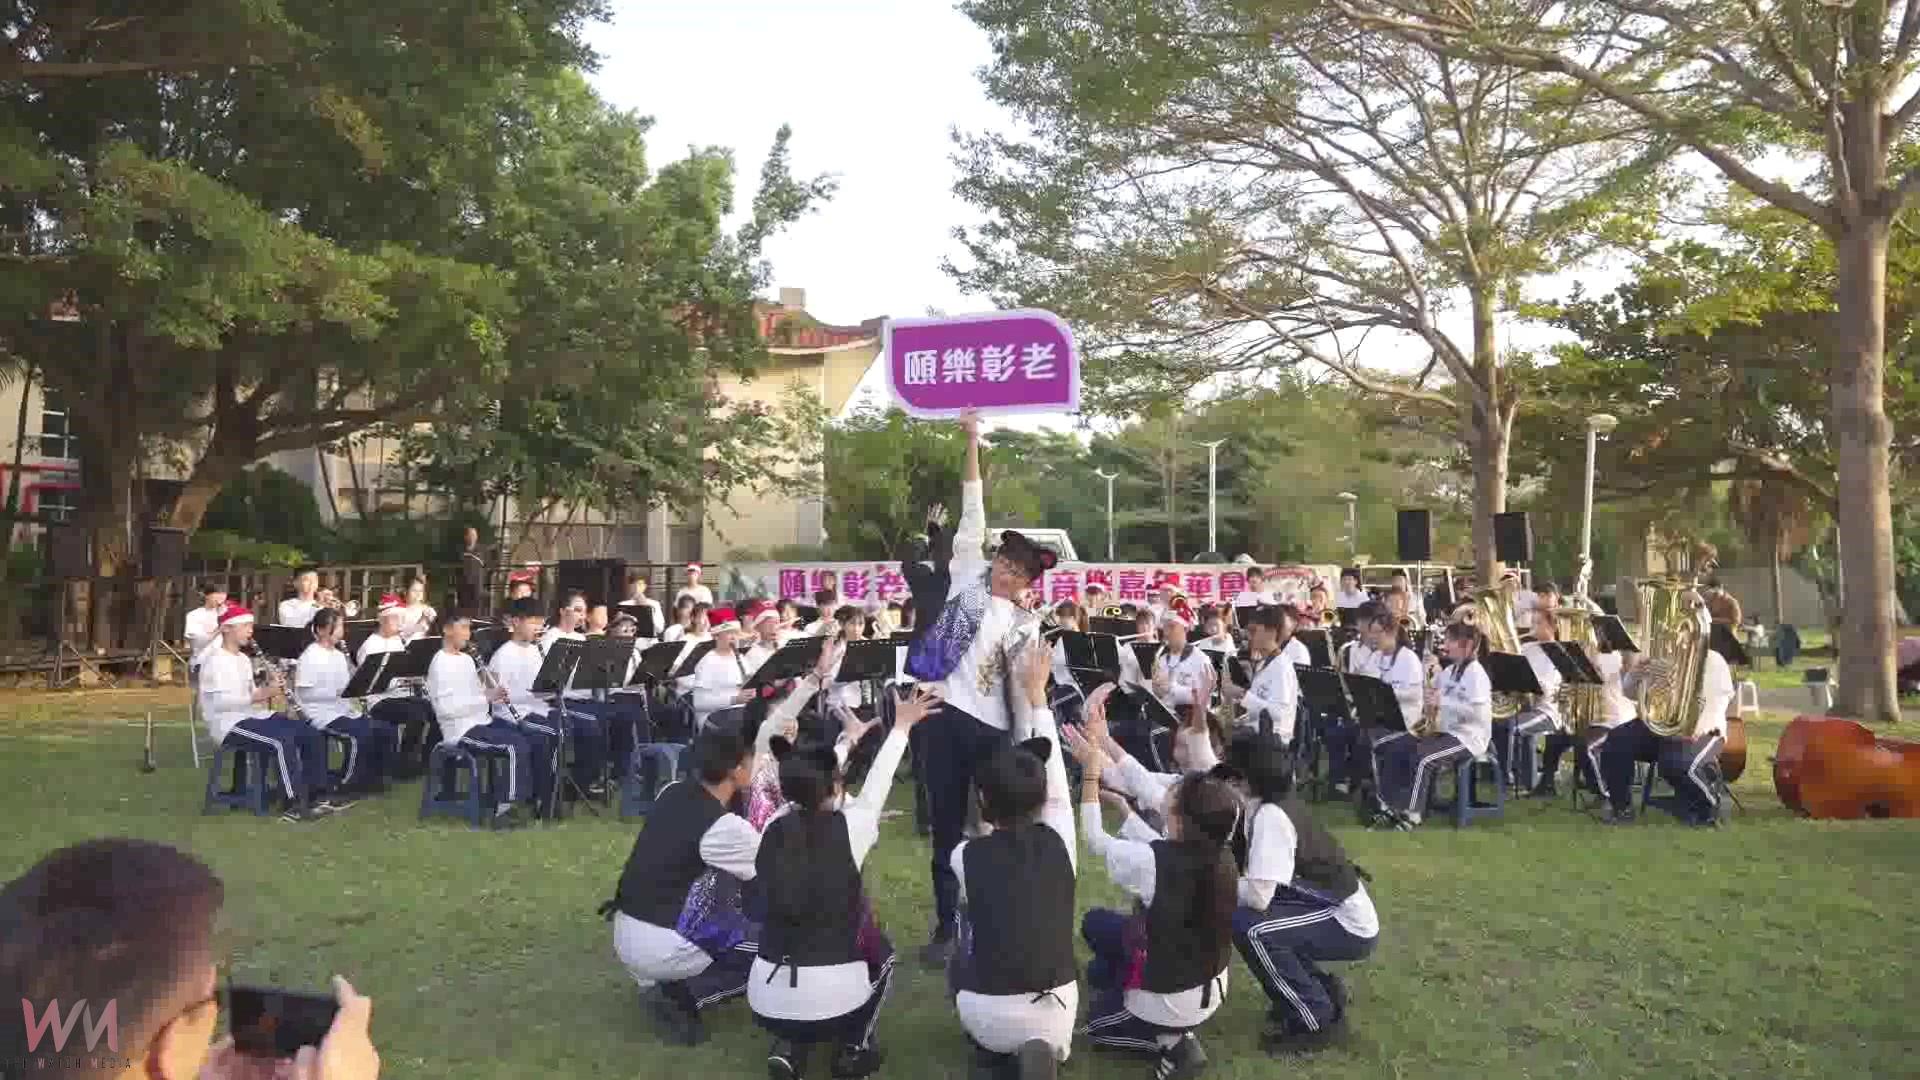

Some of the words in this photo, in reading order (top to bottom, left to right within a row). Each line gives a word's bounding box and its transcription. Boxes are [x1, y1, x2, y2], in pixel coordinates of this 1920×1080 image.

[904, 343, 1057, 385] 頤樂彰老
[1032, 569, 1245, 601] 音樂嘉年華會
